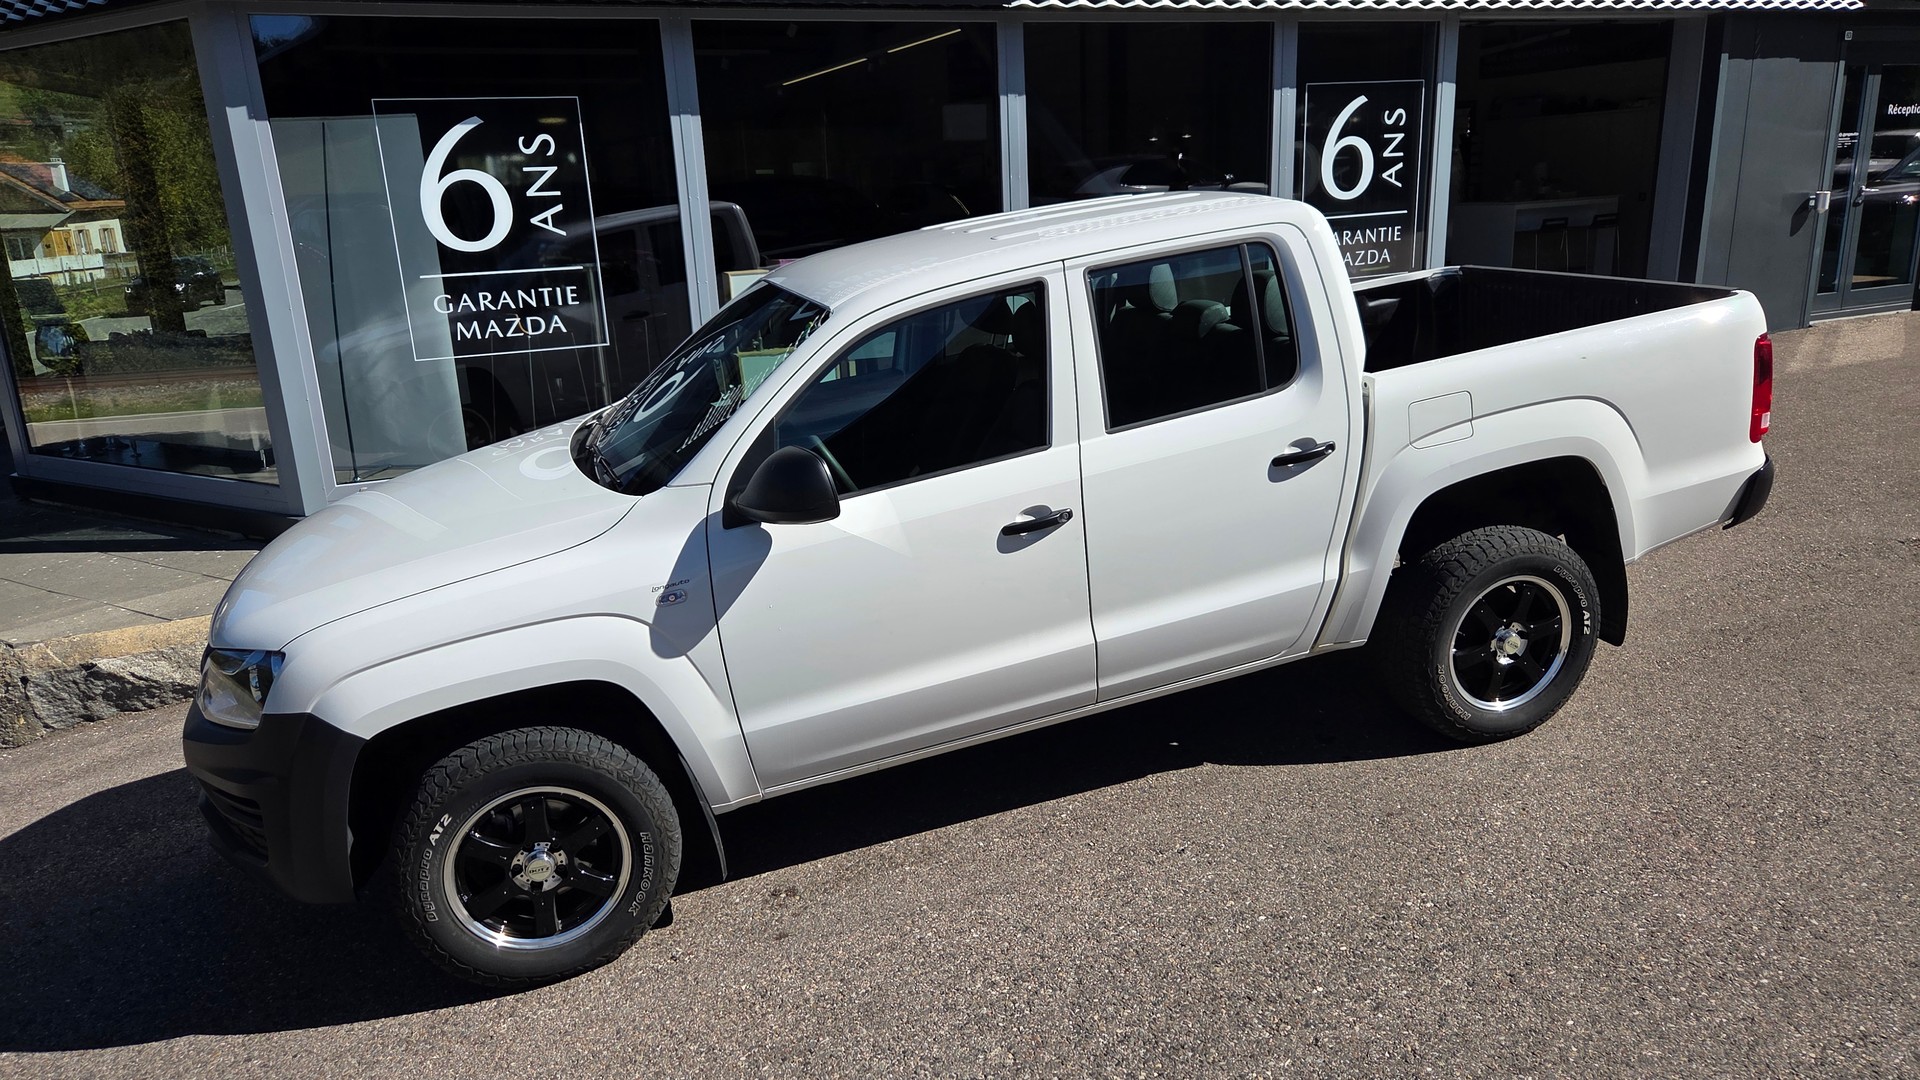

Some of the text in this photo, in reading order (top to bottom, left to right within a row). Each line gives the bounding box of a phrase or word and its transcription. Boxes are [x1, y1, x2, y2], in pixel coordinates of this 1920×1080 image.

[1321, 95, 1374, 200] 6
[1382, 108, 1406, 188] ANS
[420, 116, 513, 252] 6
[518, 134, 567, 236] ANS
[1333, 226, 1402, 247] ARANTIE
[1343, 248, 1391, 267] AZDA
[433, 285, 580, 314] GARANTIE
[456, 314, 567, 341] MAZDA
[1583, 610, 1591, 635] AT2
[429, 812, 453, 847] AT2
